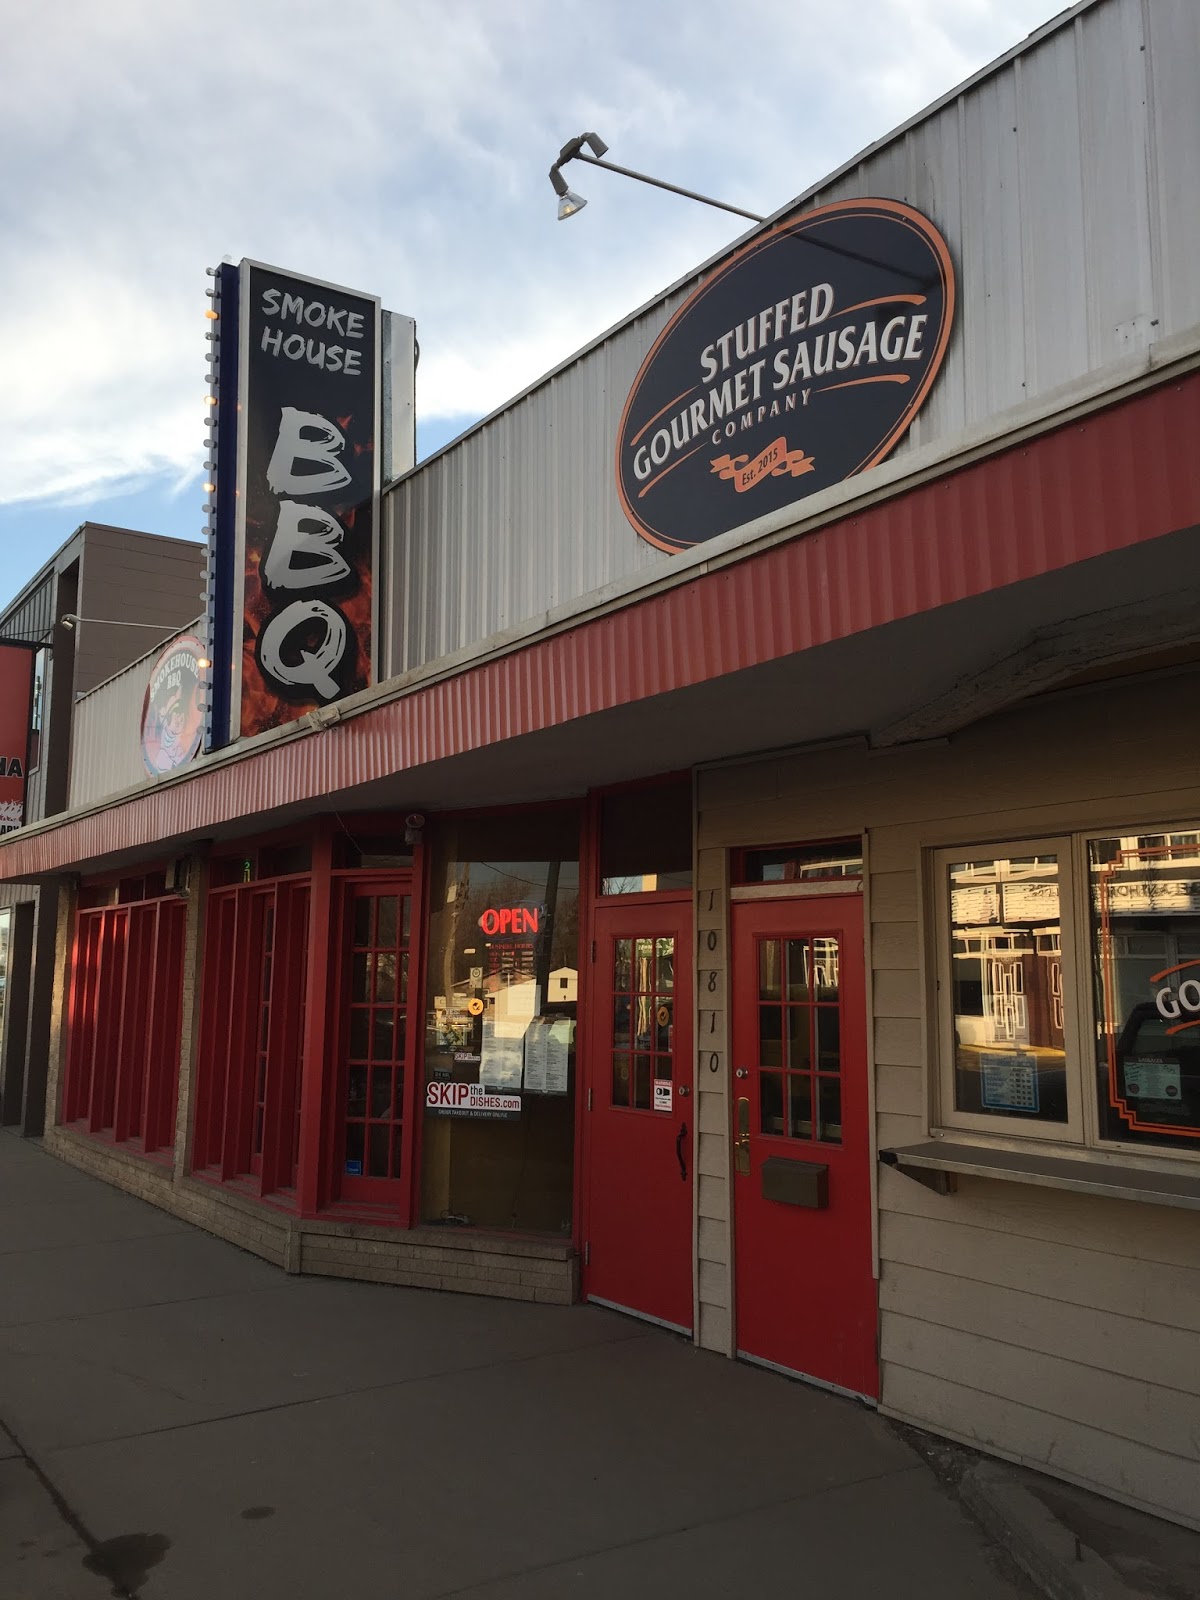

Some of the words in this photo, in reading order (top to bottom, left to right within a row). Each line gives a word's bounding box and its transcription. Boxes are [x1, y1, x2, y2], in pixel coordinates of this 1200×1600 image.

[262, 288, 364, 338] SMOKE
[700, 283, 834, 383] STUFFED
[261, 326, 362, 375] HOUSE
[633, 359, 766, 481] GOURMET
[772, 314, 928, 390] SAUSAGE
[712, 387, 812, 445] COMPANY
[742, 464, 756, 486] Est.
[758, 447, 779, 474] 2015
[260, 406, 353, 699] BBQ
[150, 652, 199, 702] SMOKEHOUSE
[167, 669, 182, 690] BBQ
[481, 907, 539, 935] OPEN
[1156, 979, 1200, 1018] GO
[428, 1083, 469, 1106] SKIP
[470, 1085, 483, 1096] the
[470, 1096, 520, 1109] DISHES.com
